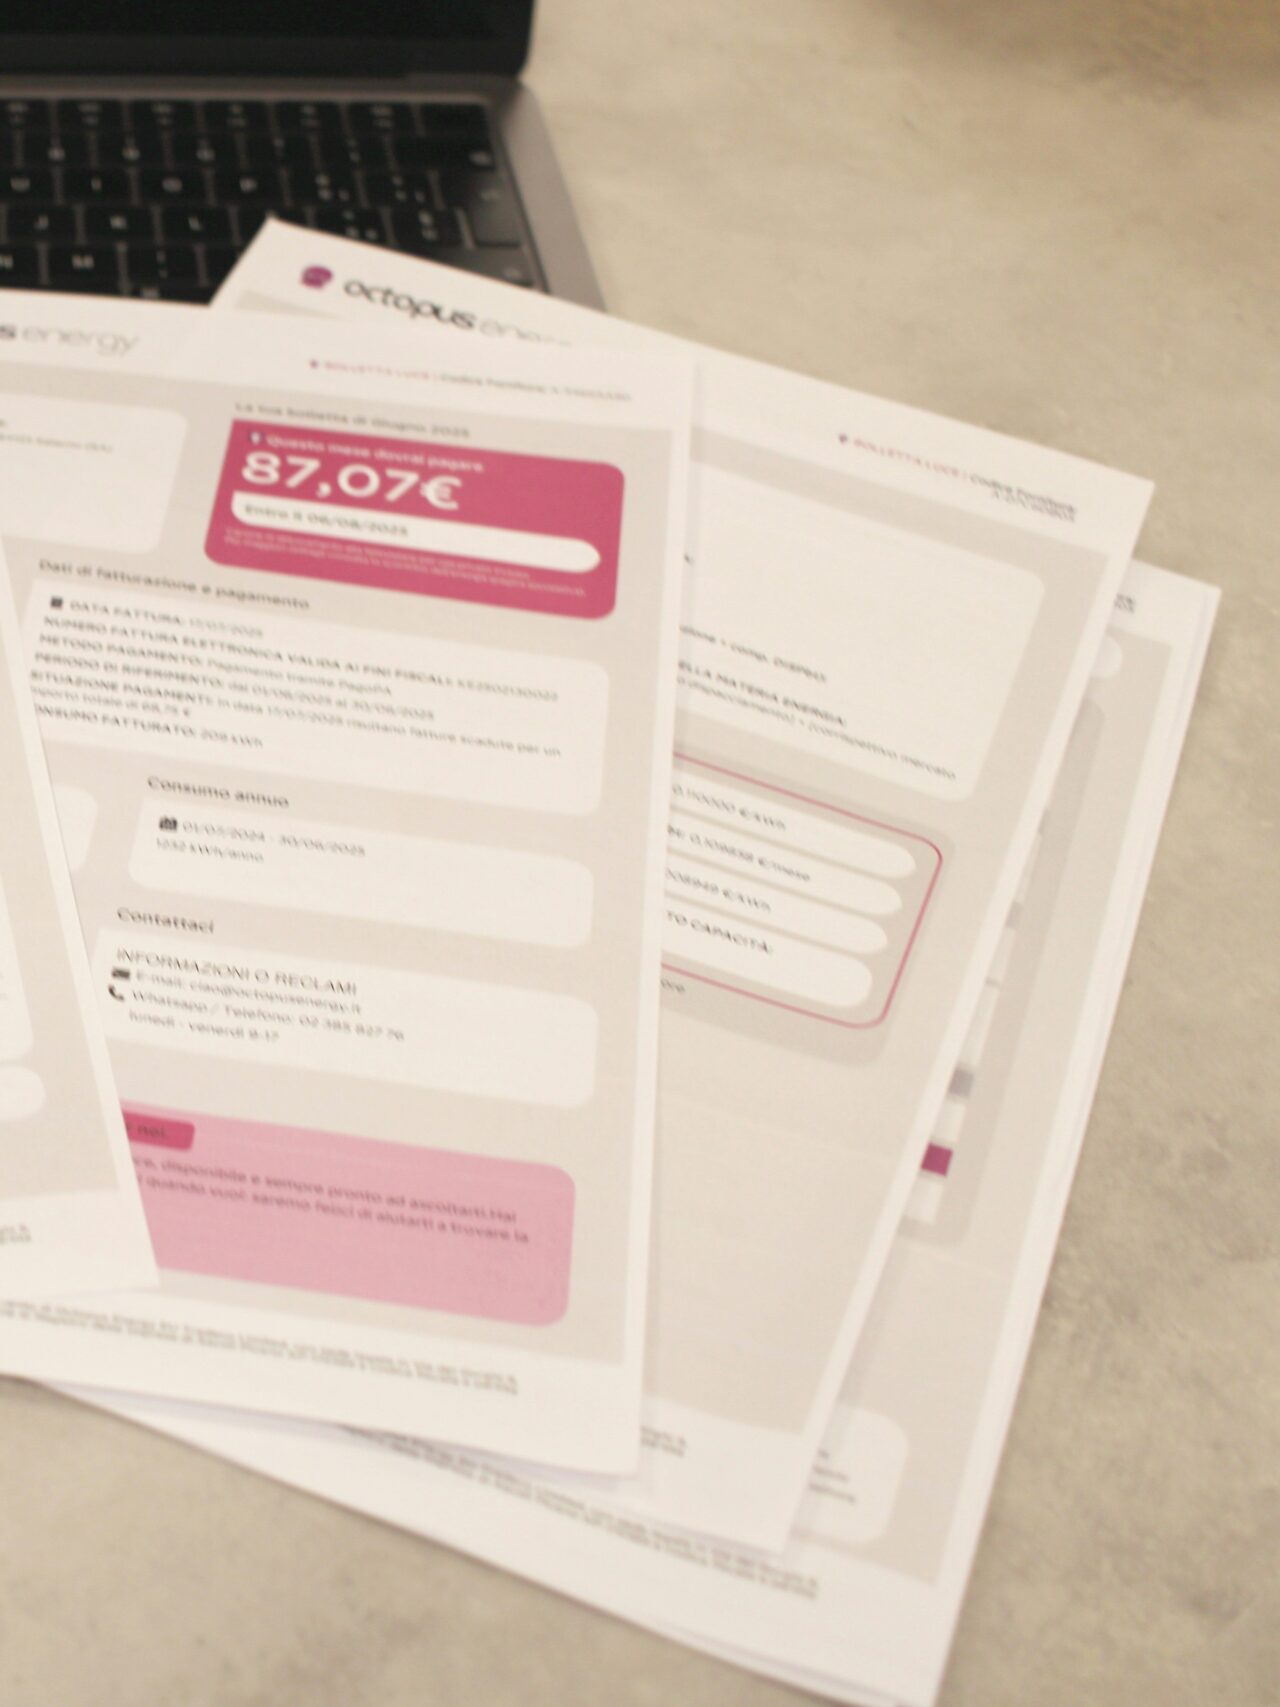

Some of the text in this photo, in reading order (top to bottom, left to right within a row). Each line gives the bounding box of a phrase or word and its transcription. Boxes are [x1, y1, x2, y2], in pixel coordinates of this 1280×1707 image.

[344, 277, 476, 333] octopus
[21, 327, 139, 357] energy
[266, 434, 485, 474] Questo mese dovrai pagare
[241, 450, 463, 511] 87,07€
[244, 503, 289, 521] Entro
[39, 559, 310, 611] Dati di fatturazione e pagamento
[70, 601, 187, 626] DATA FATTURA:
[40, 633, 103, 652] METODO
[107, 642, 204, 666] PAGAMENTO:
[208, 656, 283, 681] Pagamento
[286, 671, 335, 688] tramite
[45, 616, 107, 635] NUMERO
[111, 624, 178, 645] FATTURA
[184, 634, 283, 661] ELETTRONICA
[287, 653, 341, 671] VALIDA
[345, 660, 360, 673] AI
[363, 664, 391, 678] FINI
[35, 652, 100, 672] PERIODO
[104, 659, 119, 673] DI
[122, 663, 224, 688] RIFERIMENTO:
[102, 712, 263, 749] FATTURATO: kWh
[410, 724, 457, 743] fatture
[461, 735, 515, 752] scadute
[517, 742, 540, 756] per
[148, 776, 290, 808] Consumo annuo
[117, 906, 215, 935] Contattaci
[116, 947, 357, 997] INFORMAZIONI O RECLAMI
[136, 969, 186, 991] E-mail:
[132, 989, 208, 1015] Whatsapp
[224, 1004, 294, 1026] Telefono:
[160, 1158, 247, 1183] disponibile
[265, 1176, 324, 1196] sempre
[328, 1183, 383, 1201] pronto
[387, 1190, 406, 1203] ad
[146, 1174, 206, 1197] quando
[252, 1191, 311, 1212] saremo
[315, 1199, 353, 1218] felici
[356, 1206, 372, 1222] di
[375, 1209, 434, 1232] aiutarti
[450, 1222, 510, 1243] trovare
[514, 1230, 529, 1244] la
